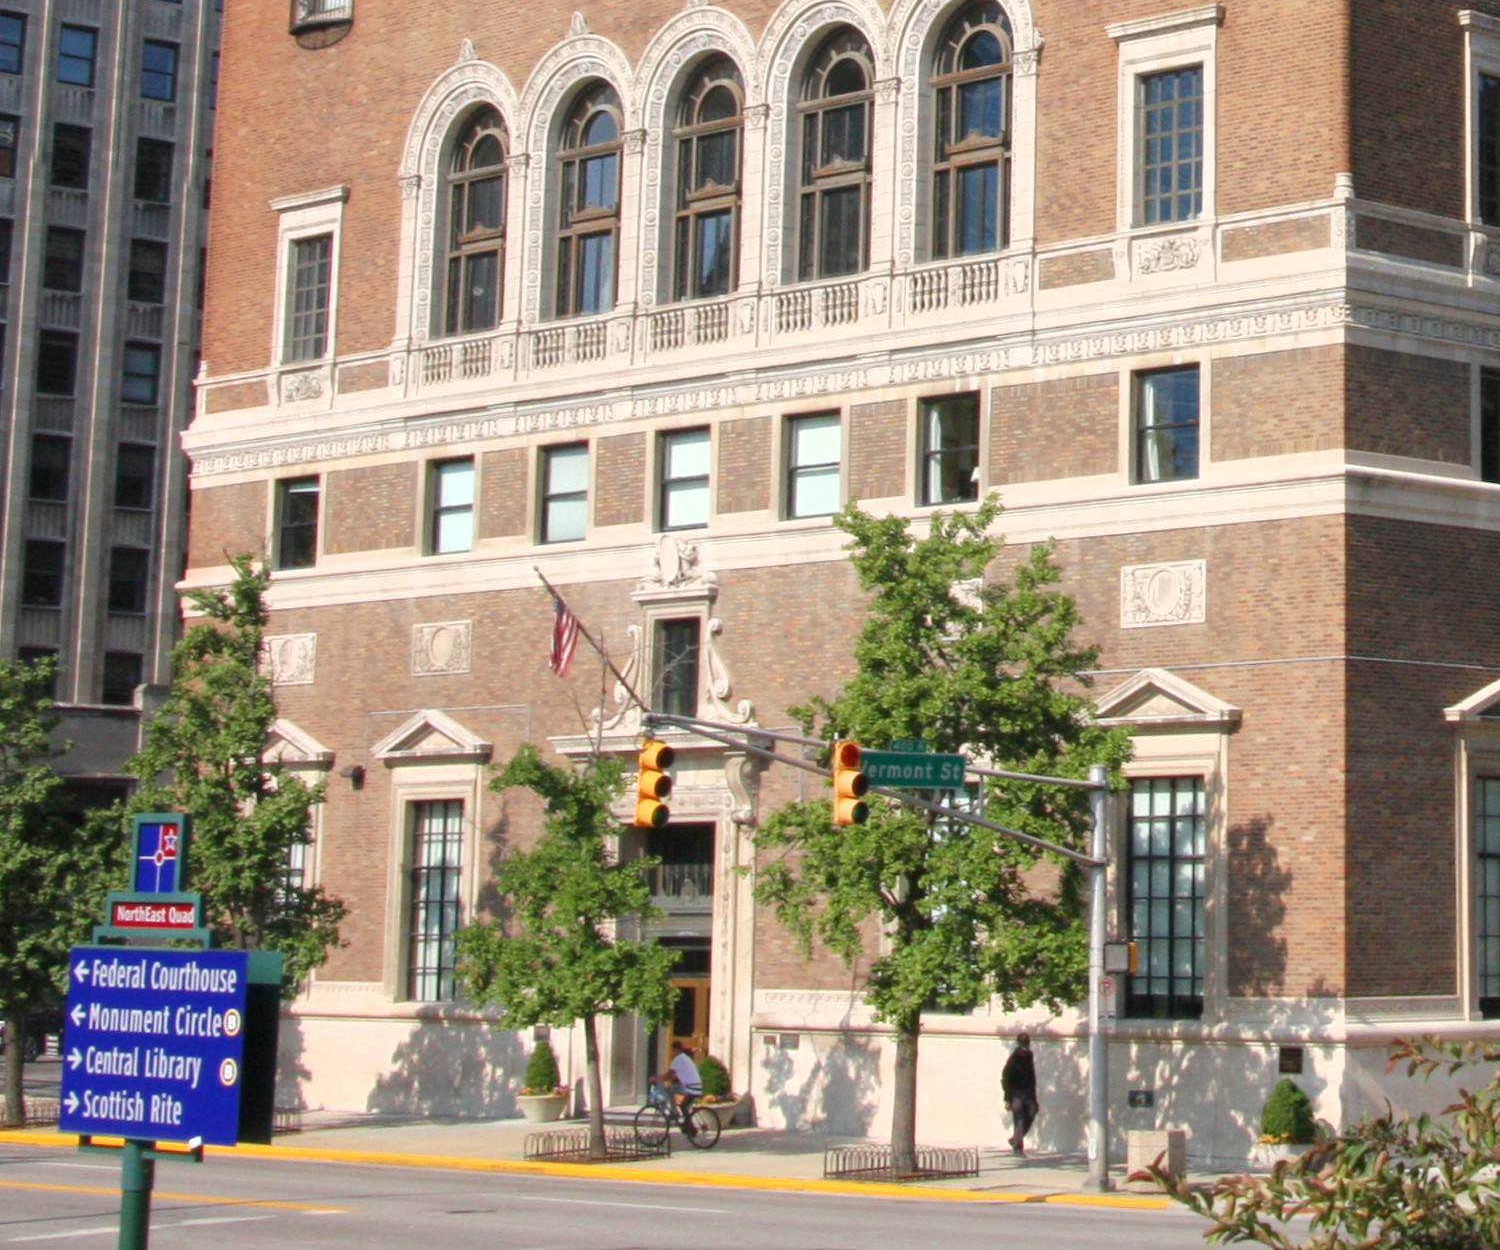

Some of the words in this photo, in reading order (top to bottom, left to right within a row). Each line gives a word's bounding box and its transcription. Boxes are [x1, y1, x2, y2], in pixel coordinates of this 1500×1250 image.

[940, 762, 960, 780] St
[117, 906, 167, 923] NorthEast
[169, 907, 195, 924] Quad
[92, 958, 146, 989] Federal
[151, 961, 237, 993] Courthouse
[88, 1003, 169, 1034] Monument
[175, 1006, 222, 1038] Circle
[86, 1046, 138, 1077] Central
[145, 1048, 202, 1089] Library
[83, 1090, 144, 1122] Scottish
[151, 1092, 182, 1125] Rite
